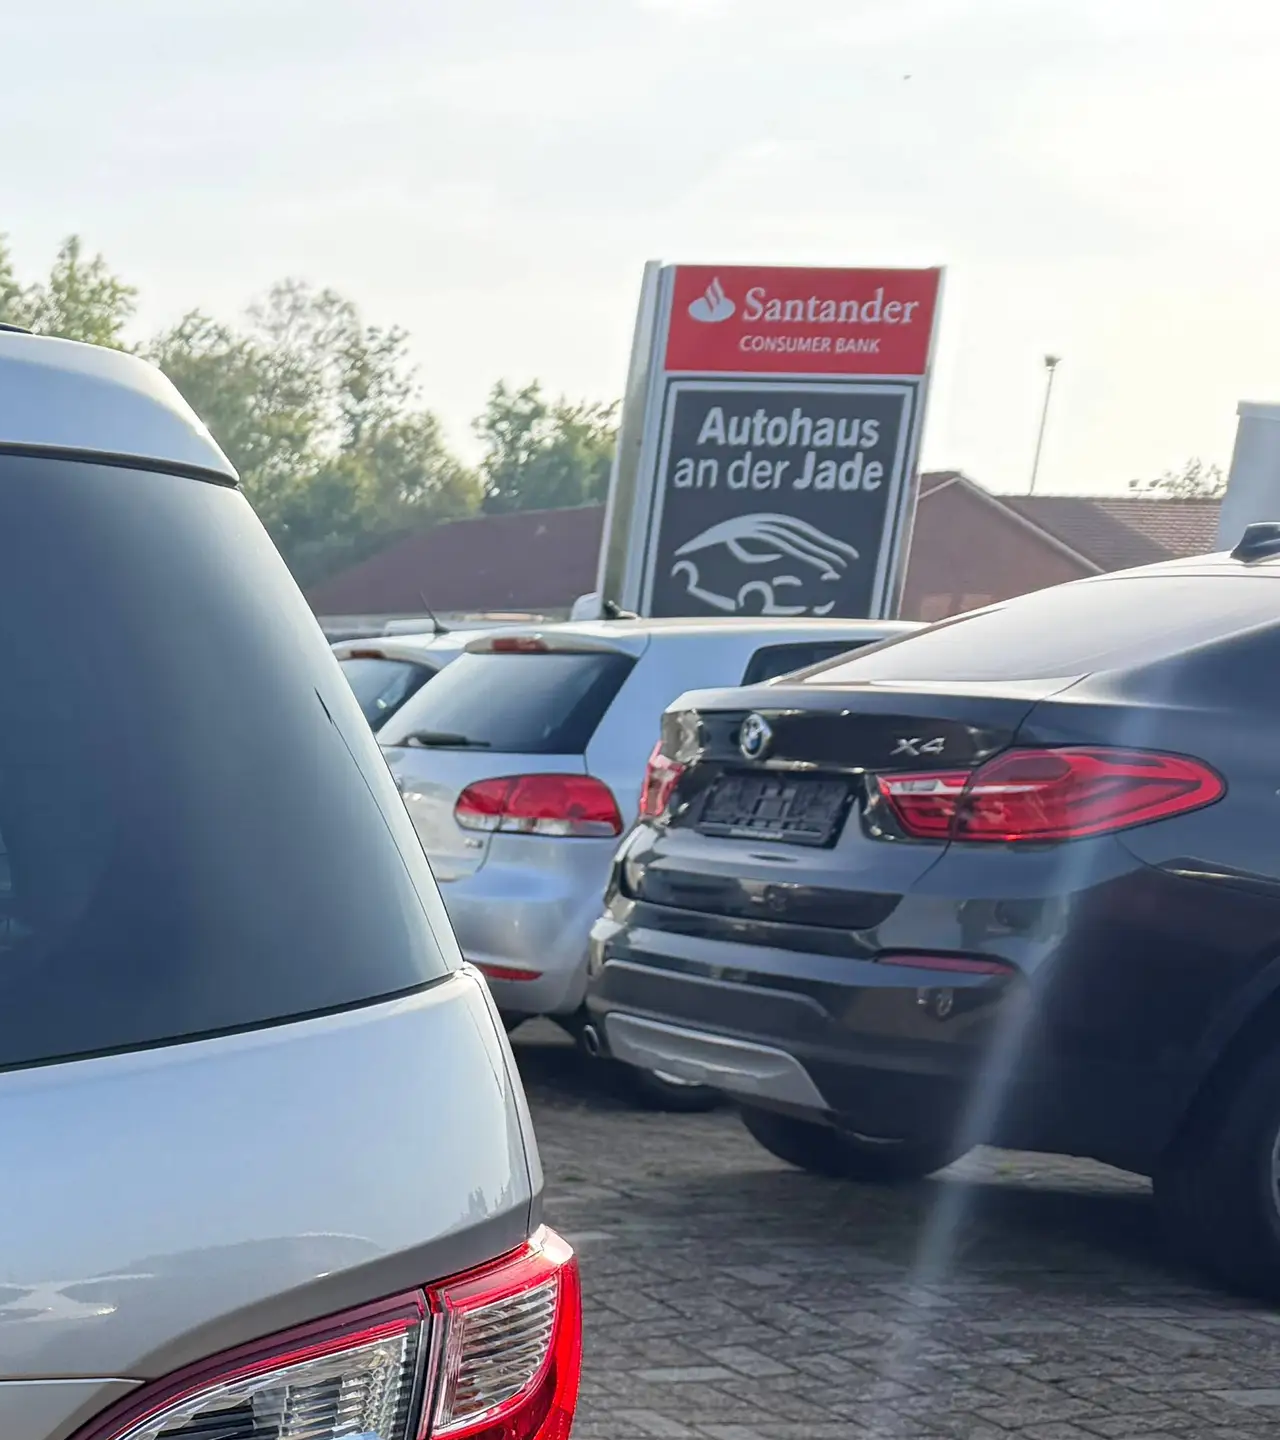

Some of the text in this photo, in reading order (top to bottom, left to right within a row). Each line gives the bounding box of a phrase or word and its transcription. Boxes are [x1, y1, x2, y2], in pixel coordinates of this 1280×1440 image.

[743, 287, 919, 326] Santander
[740, 335, 881, 354] CONSUMER BANK
[697, 406, 881, 449] Autohaus
[674, 451, 884, 491] an der Jade
[891, 737, 945, 756] X4
